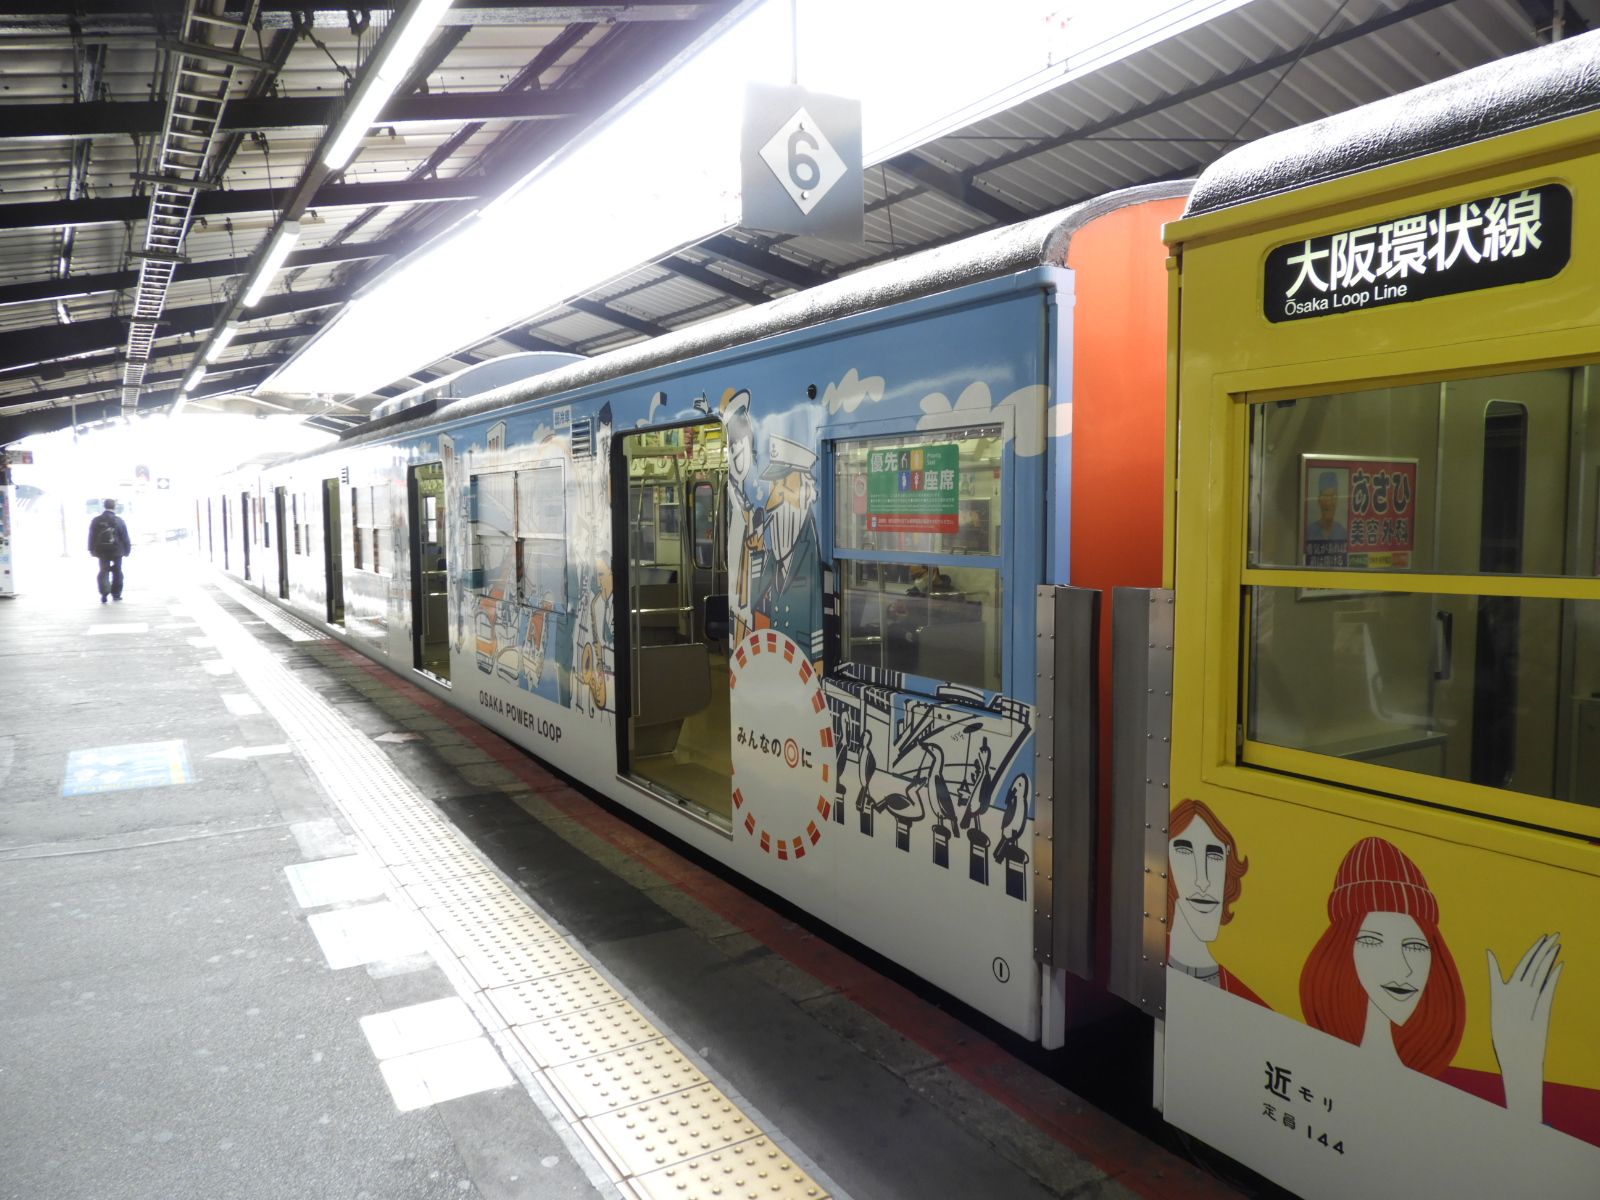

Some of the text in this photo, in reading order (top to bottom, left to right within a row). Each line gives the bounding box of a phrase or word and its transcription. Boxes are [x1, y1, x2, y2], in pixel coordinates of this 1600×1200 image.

[788, 131, 820, 190] 6
[1285, 190, 1543, 298] 大阪環状線
[1285, 284, 1407, 316] Ōsaka Loop Line
[871, 452, 898, 472] 優先
[924, 469, 954, 490] 座席
[1351, 467, 1411, 516] あさひ
[1351, 517, 1409, 546] 美容外科
[480, 690, 562, 743] OSAKA POWER LOOP
